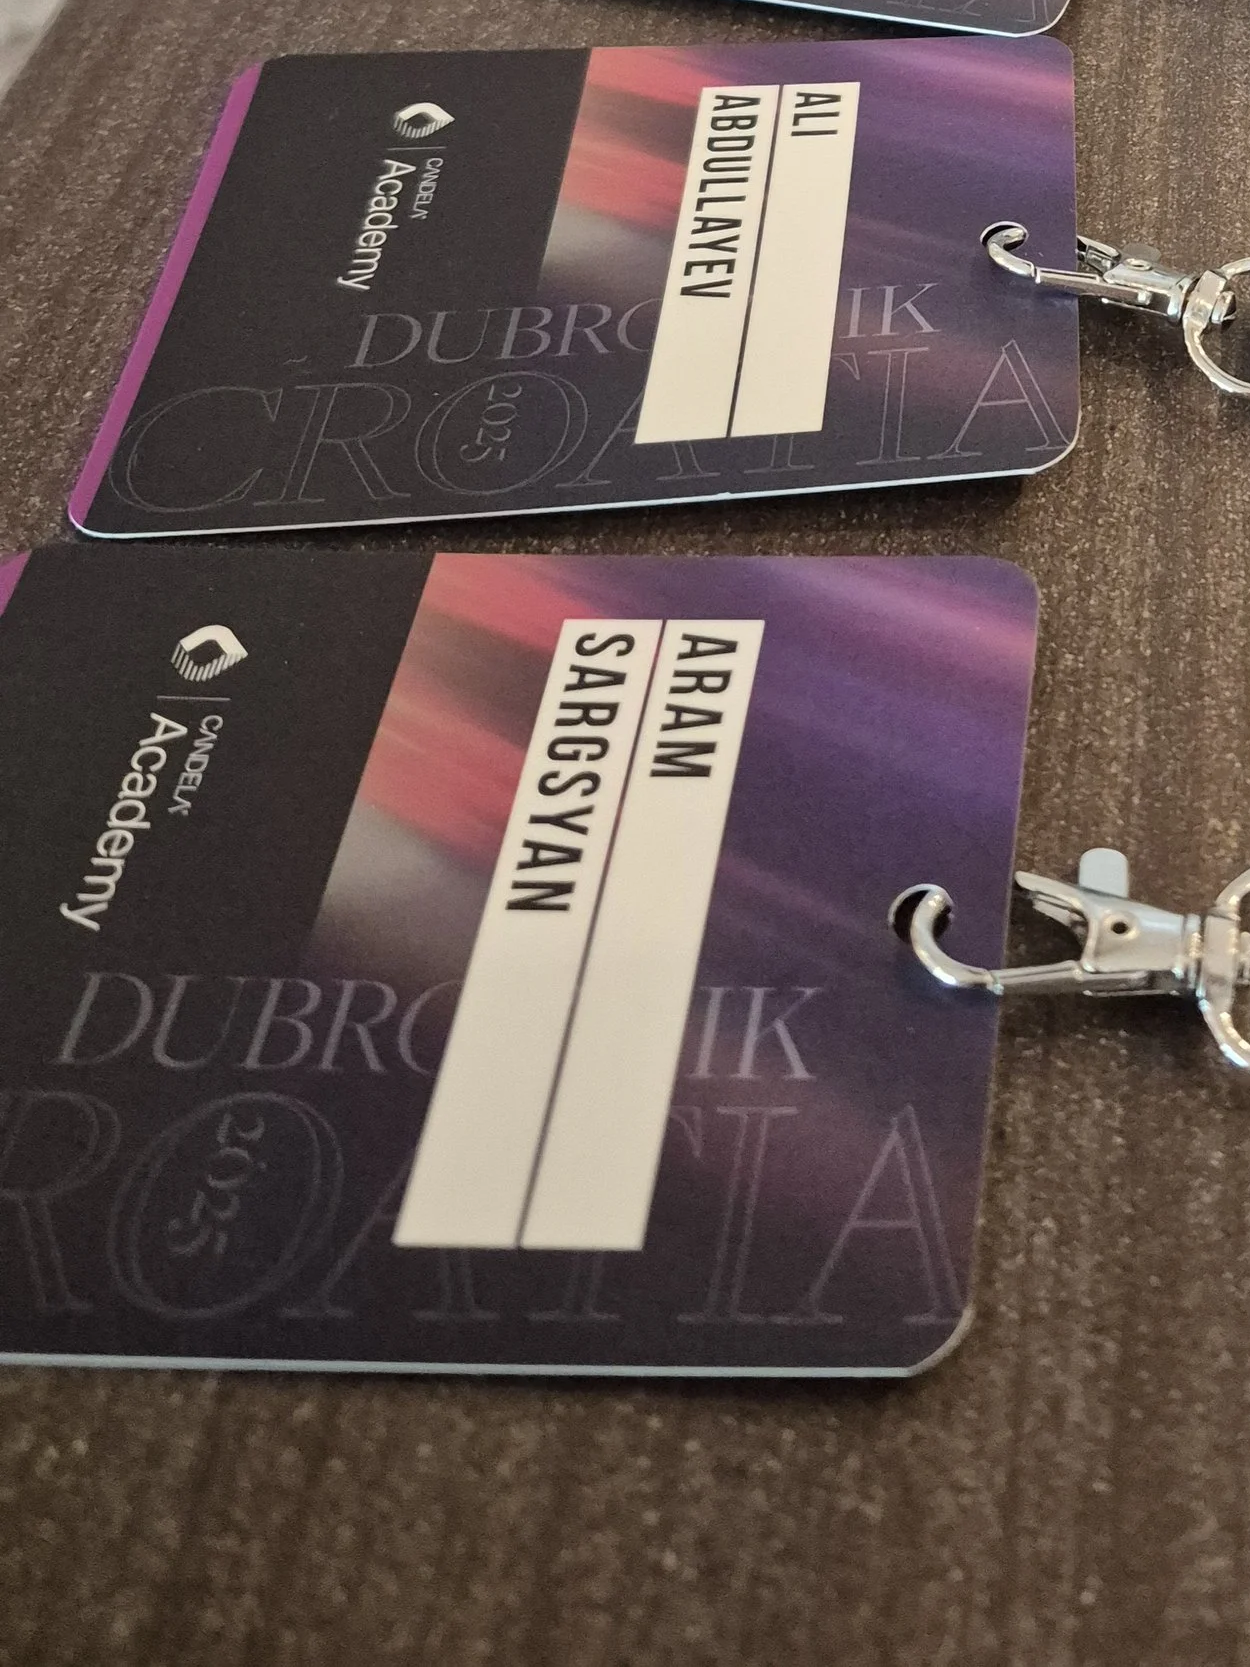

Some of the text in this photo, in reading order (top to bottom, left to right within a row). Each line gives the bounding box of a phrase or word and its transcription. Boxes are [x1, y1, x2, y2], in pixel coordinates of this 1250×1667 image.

[791, 91, 842, 136] ALI
[336, 158, 417, 292] Academy
[679, 94, 761, 299] ABDULLAYEV
[344, 283, 941, 369] DUBRIK
[505, 632, 636, 912] SARGSYAN
[650, 632, 739, 777] ARAM
[59, 711, 188, 932] Academy
[45, 971, 823, 1080] DUBRIK
